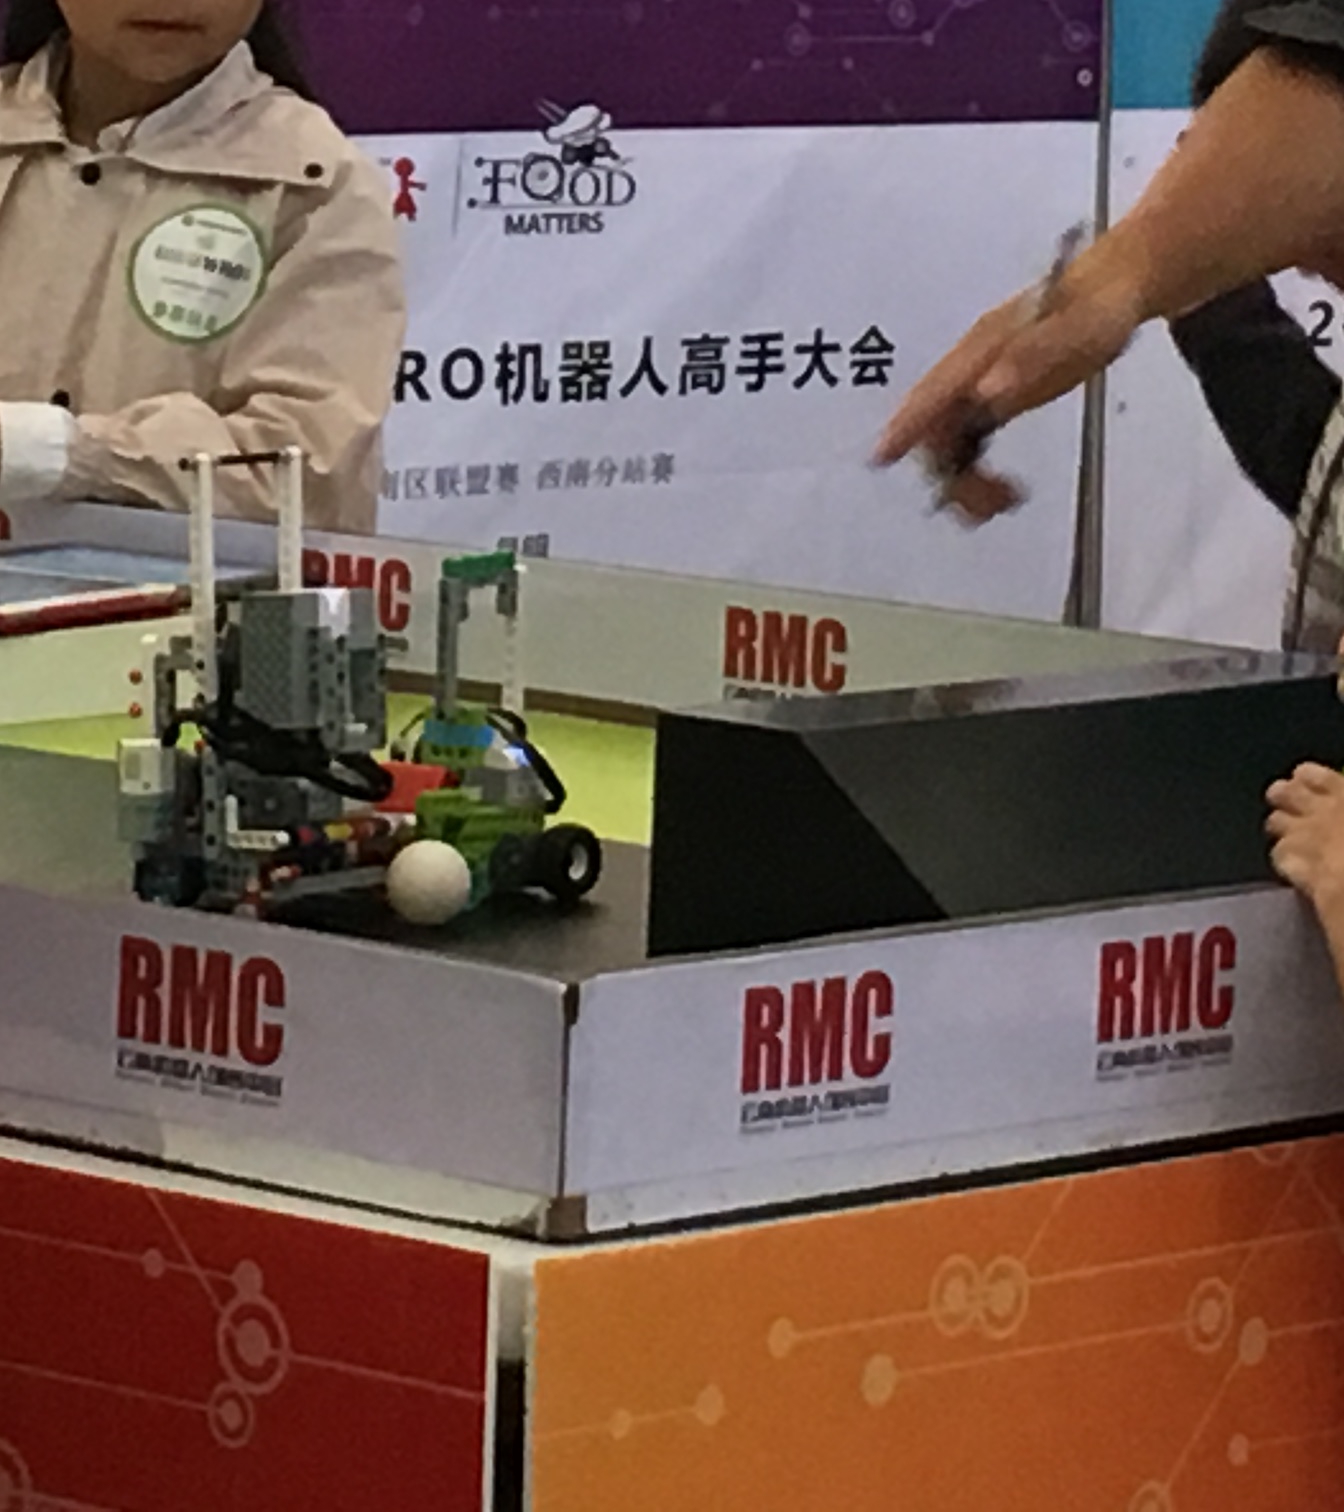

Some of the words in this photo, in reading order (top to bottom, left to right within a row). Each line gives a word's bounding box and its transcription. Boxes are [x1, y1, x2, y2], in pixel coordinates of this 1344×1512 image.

[504, 211, 605, 235] MATTERS
[723, 605, 847, 693] RMC
[117, 934, 286, 1066] RMC
[741, 970, 894, 1094] RMC
[1096, 925, 1236, 1044] RMC
